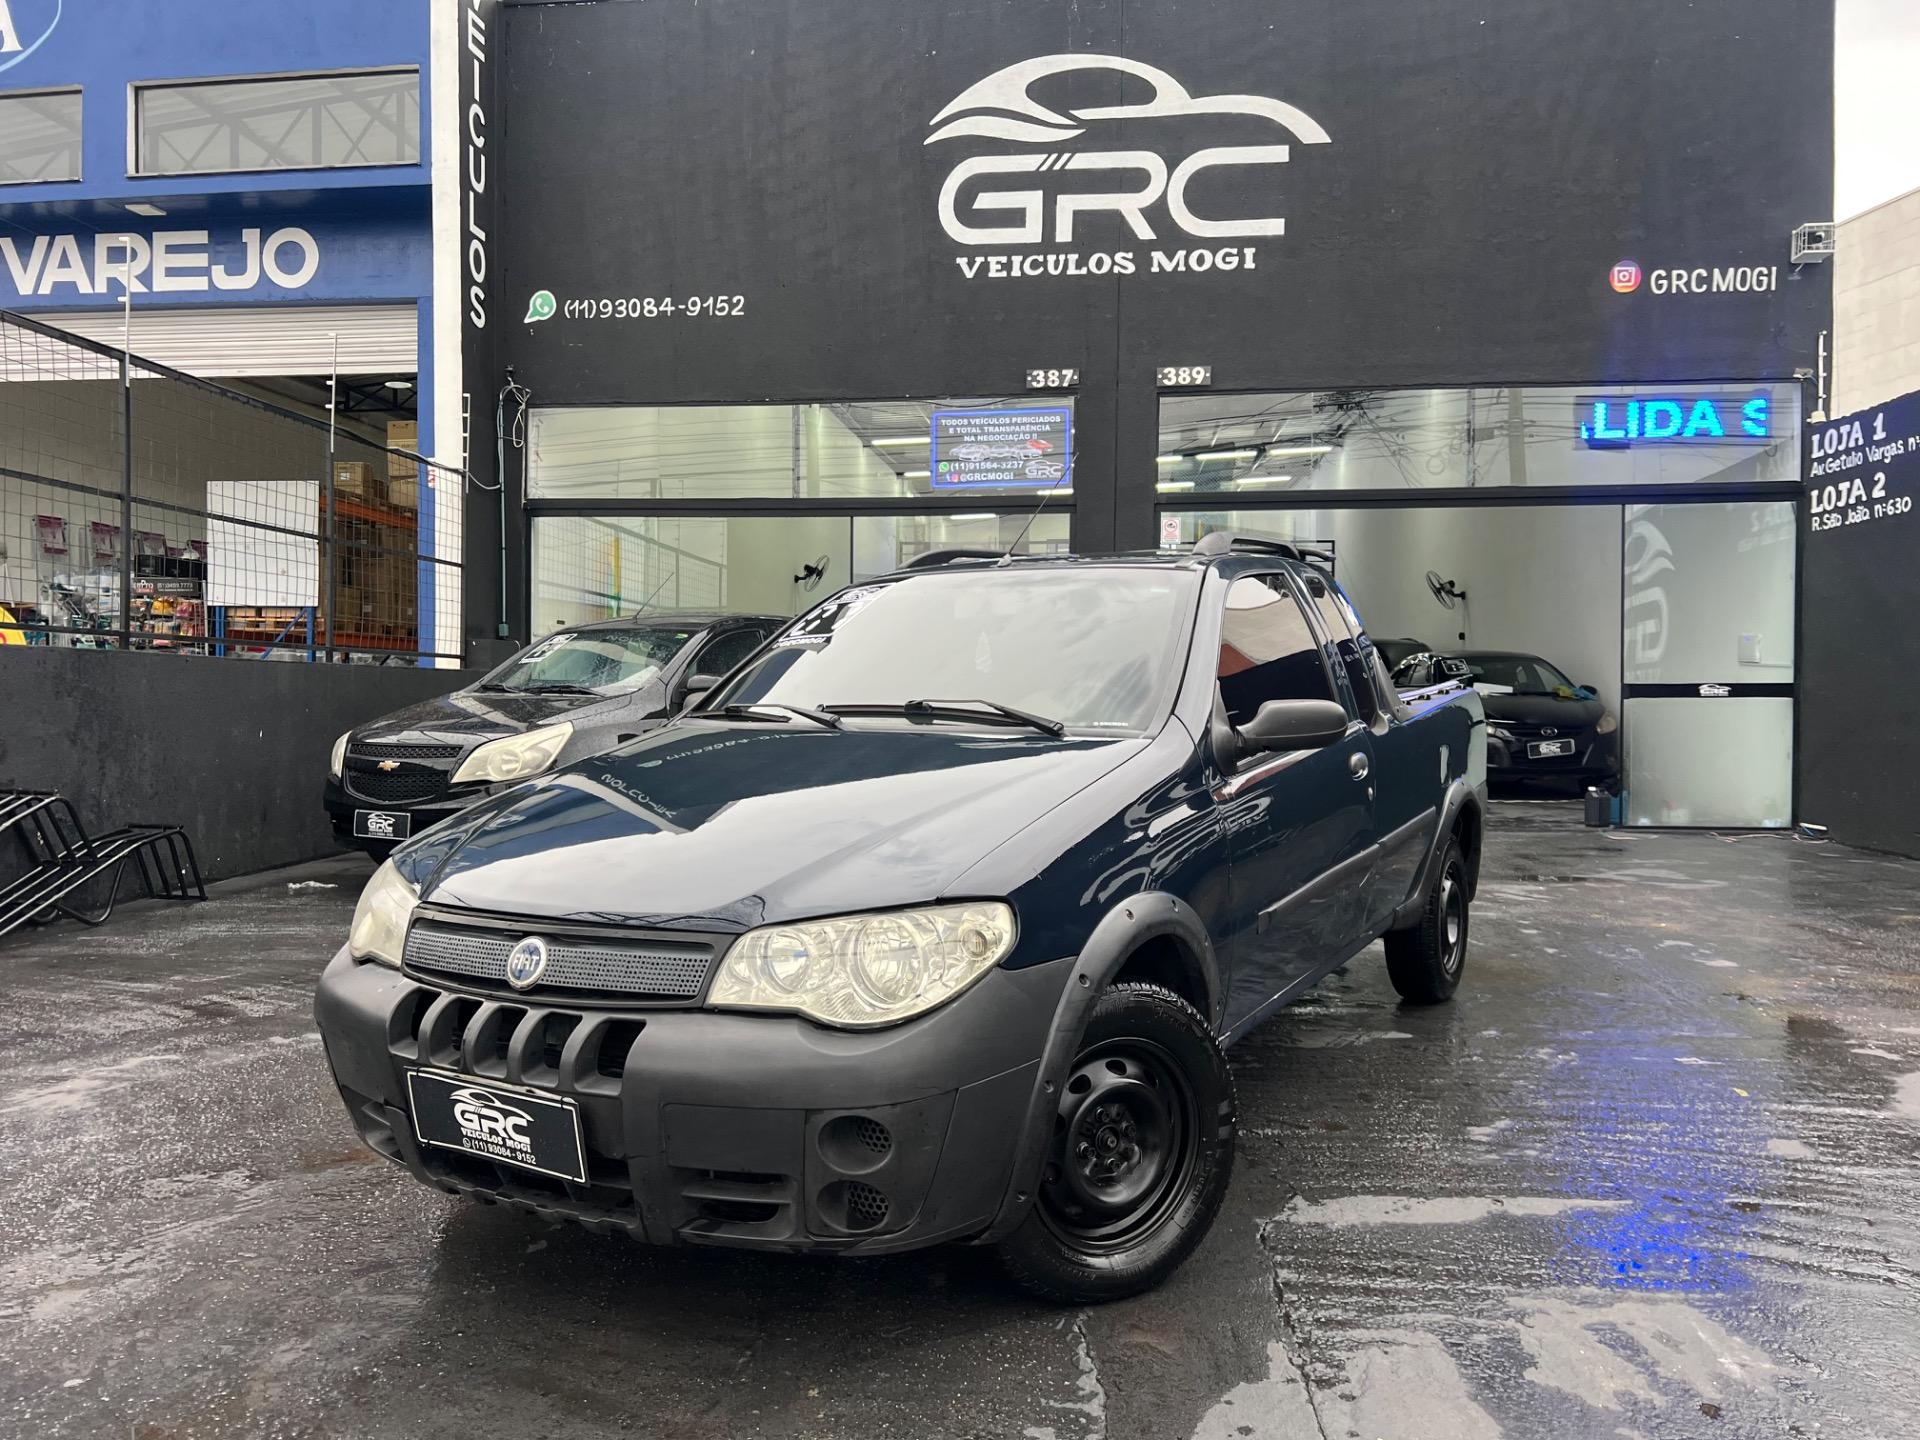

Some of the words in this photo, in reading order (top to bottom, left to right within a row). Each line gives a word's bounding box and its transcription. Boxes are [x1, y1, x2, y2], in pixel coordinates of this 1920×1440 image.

[467, 0, 487, 329] EICULOS
[938, 145, 1290, 245] GRC
[0, 227, 319, 295] VAREJO
[956, 252, 1136, 279] VEICULOS
[1151, 247, 1256, 274] MOGI
[1650, 266, 1777, 295] GRCMOGI
[1031, 369, 1074, 388] 387
[1162, 366, 1206, 386] 389
[941, 418, 968, 426] TODOS
[1012, 415, 1061, 424] PERICIADOS
[956, 426, 981, 434] TOTAL
[984, 424, 1051, 433] TRANSPARÊNCIA
[977, 433, 1030, 442] NEGOCIAÇÃO
[1811, 421, 1864, 459] LOJA
[1872, 412, 1887, 440] 1
[1865, 440, 1904, 464] Vargas
[1810, 478, 1867, 513] LOJA
[1871, 472, 1886, 498] 2
[367, 819, 393, 831] GRC
[512, 953, 540, 971] FIAT
[454, 1103, 530, 1143] GRC
[460, 1127, 504, 1145] VEICULOS
[505, 1138, 532, 1153] MOGI
